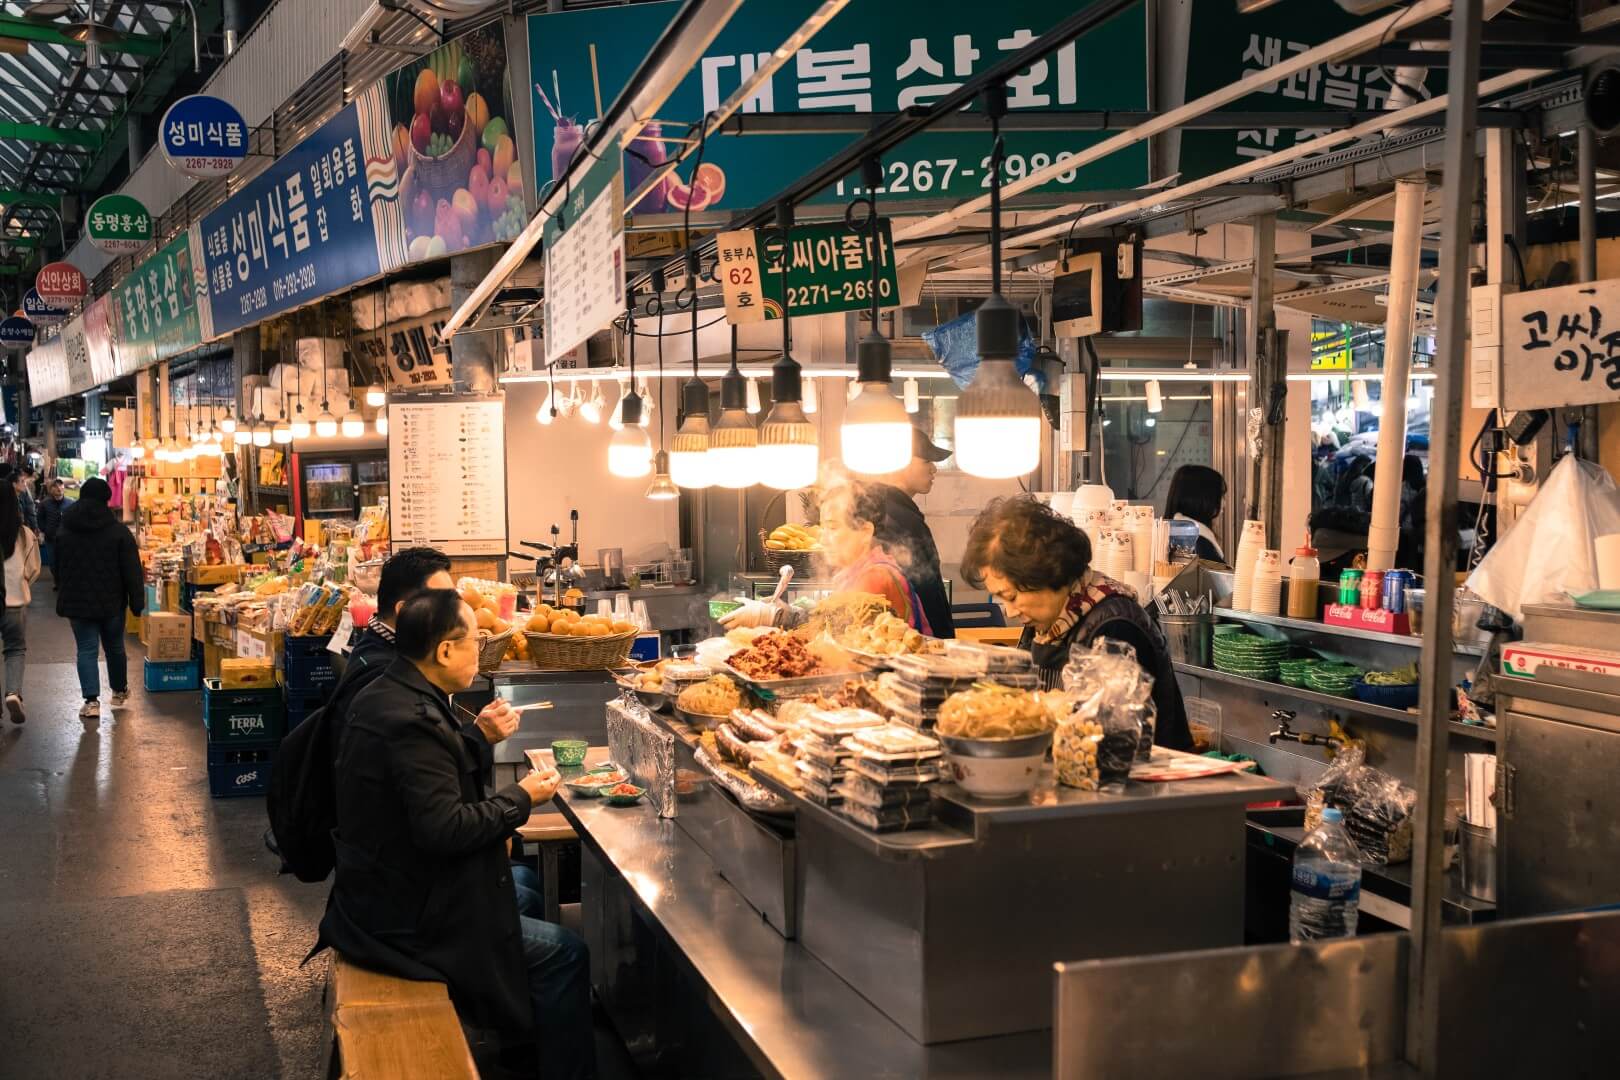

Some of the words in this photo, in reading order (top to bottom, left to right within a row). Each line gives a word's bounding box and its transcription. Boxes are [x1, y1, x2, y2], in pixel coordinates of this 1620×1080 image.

[701, 29, 1077, 119] 대복상회
[168, 121, 243, 147] 성미식품
[186, 158, 234, 169] 2267-2928
[310, 137, 357, 200] 일회용품
[91, 213, 149, 233] 동명홍삼
[231, 171, 311, 282] 성미식품
[722, 246, 755, 262] 동부A
[41, 271, 82, 292] 신안상회
[729, 267, 753, 285] 62
[124, 254, 180, 340] 동명홍삼
[737, 291, 754, 308] 호
[1521, 305, 1602, 350] 고씨
[228, 714, 265, 730] TERRA
